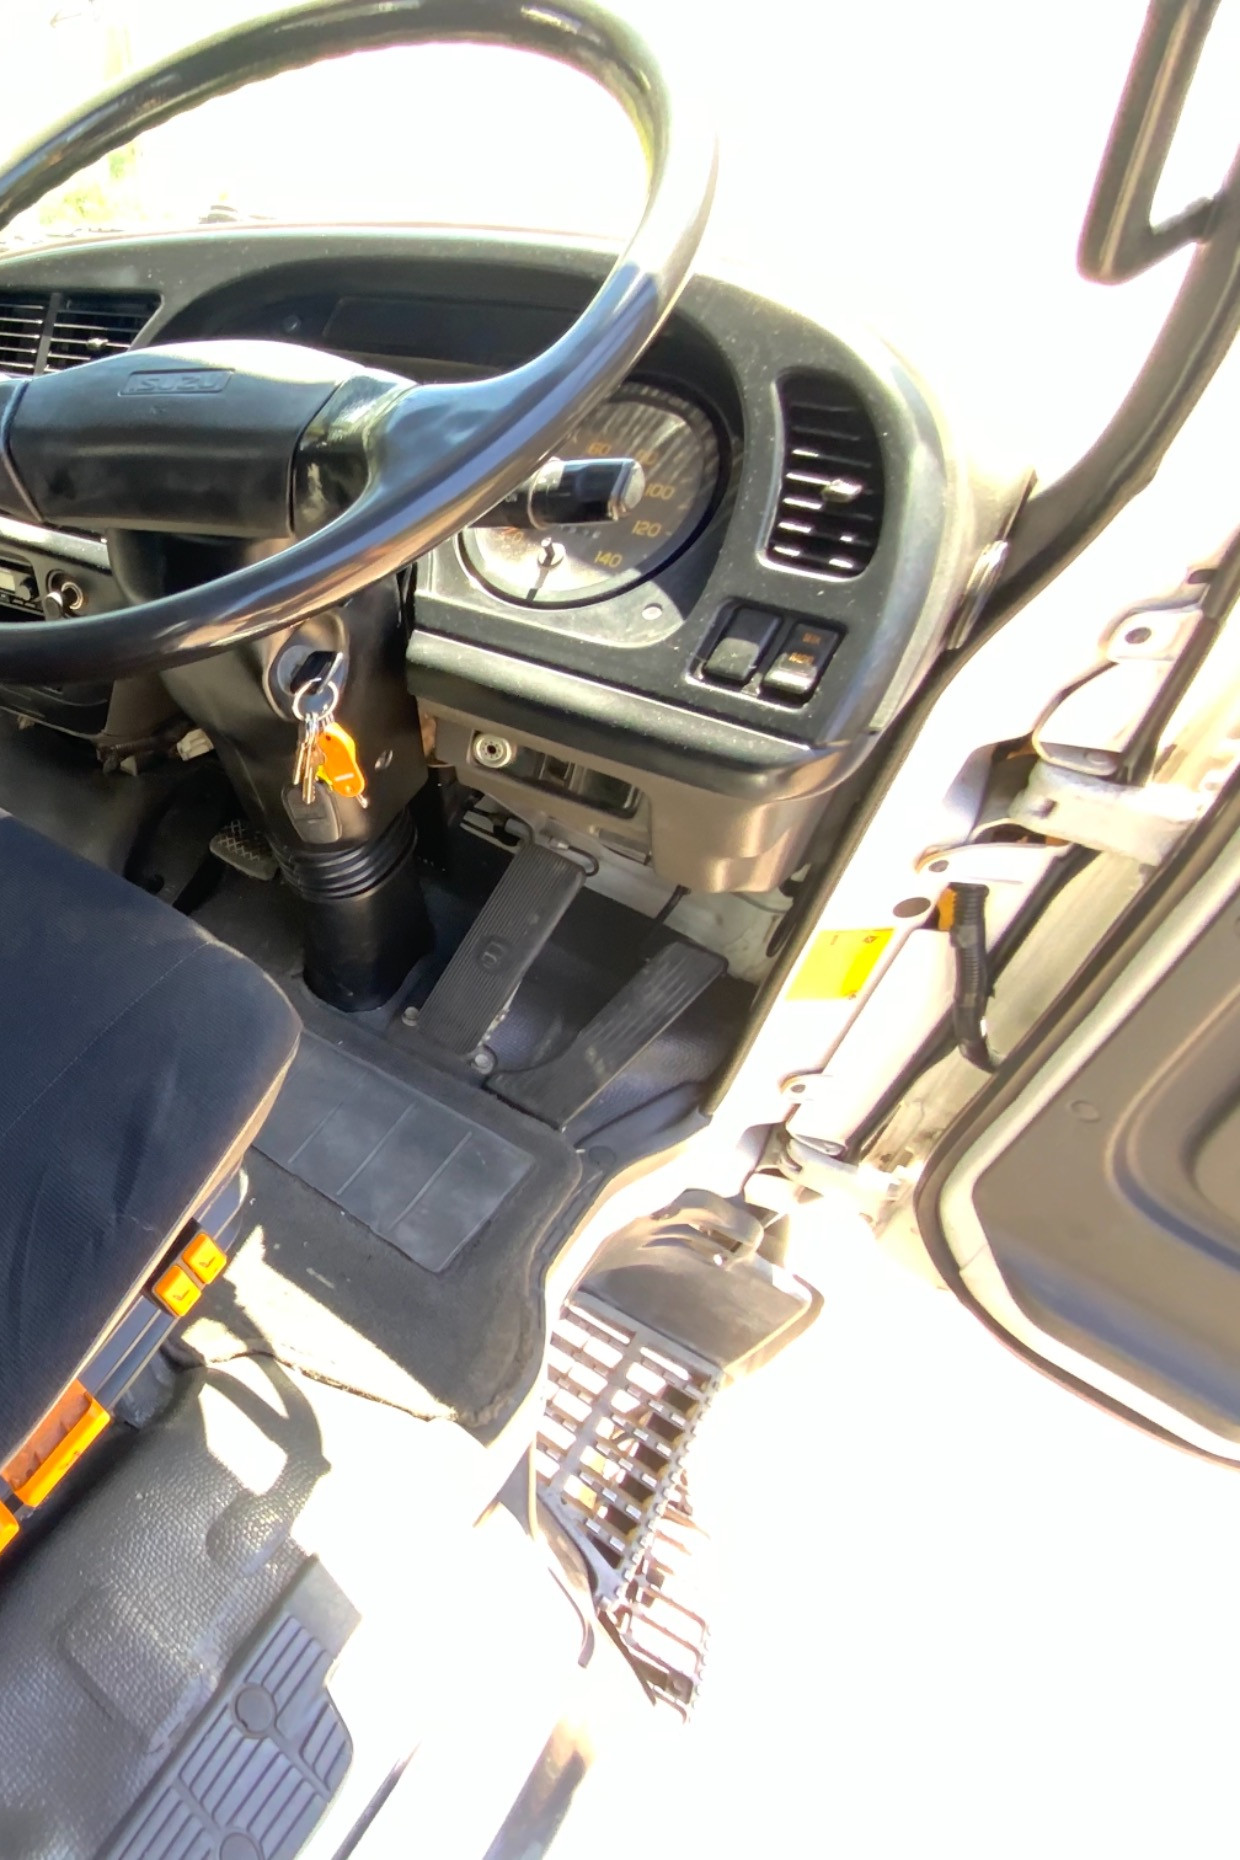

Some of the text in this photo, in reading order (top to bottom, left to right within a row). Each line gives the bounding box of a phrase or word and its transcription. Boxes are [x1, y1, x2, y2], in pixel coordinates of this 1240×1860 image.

[645, 483, 675, 500] 100
[632, 520, 661, 538] 120
[594, 550, 622, 567] 140
